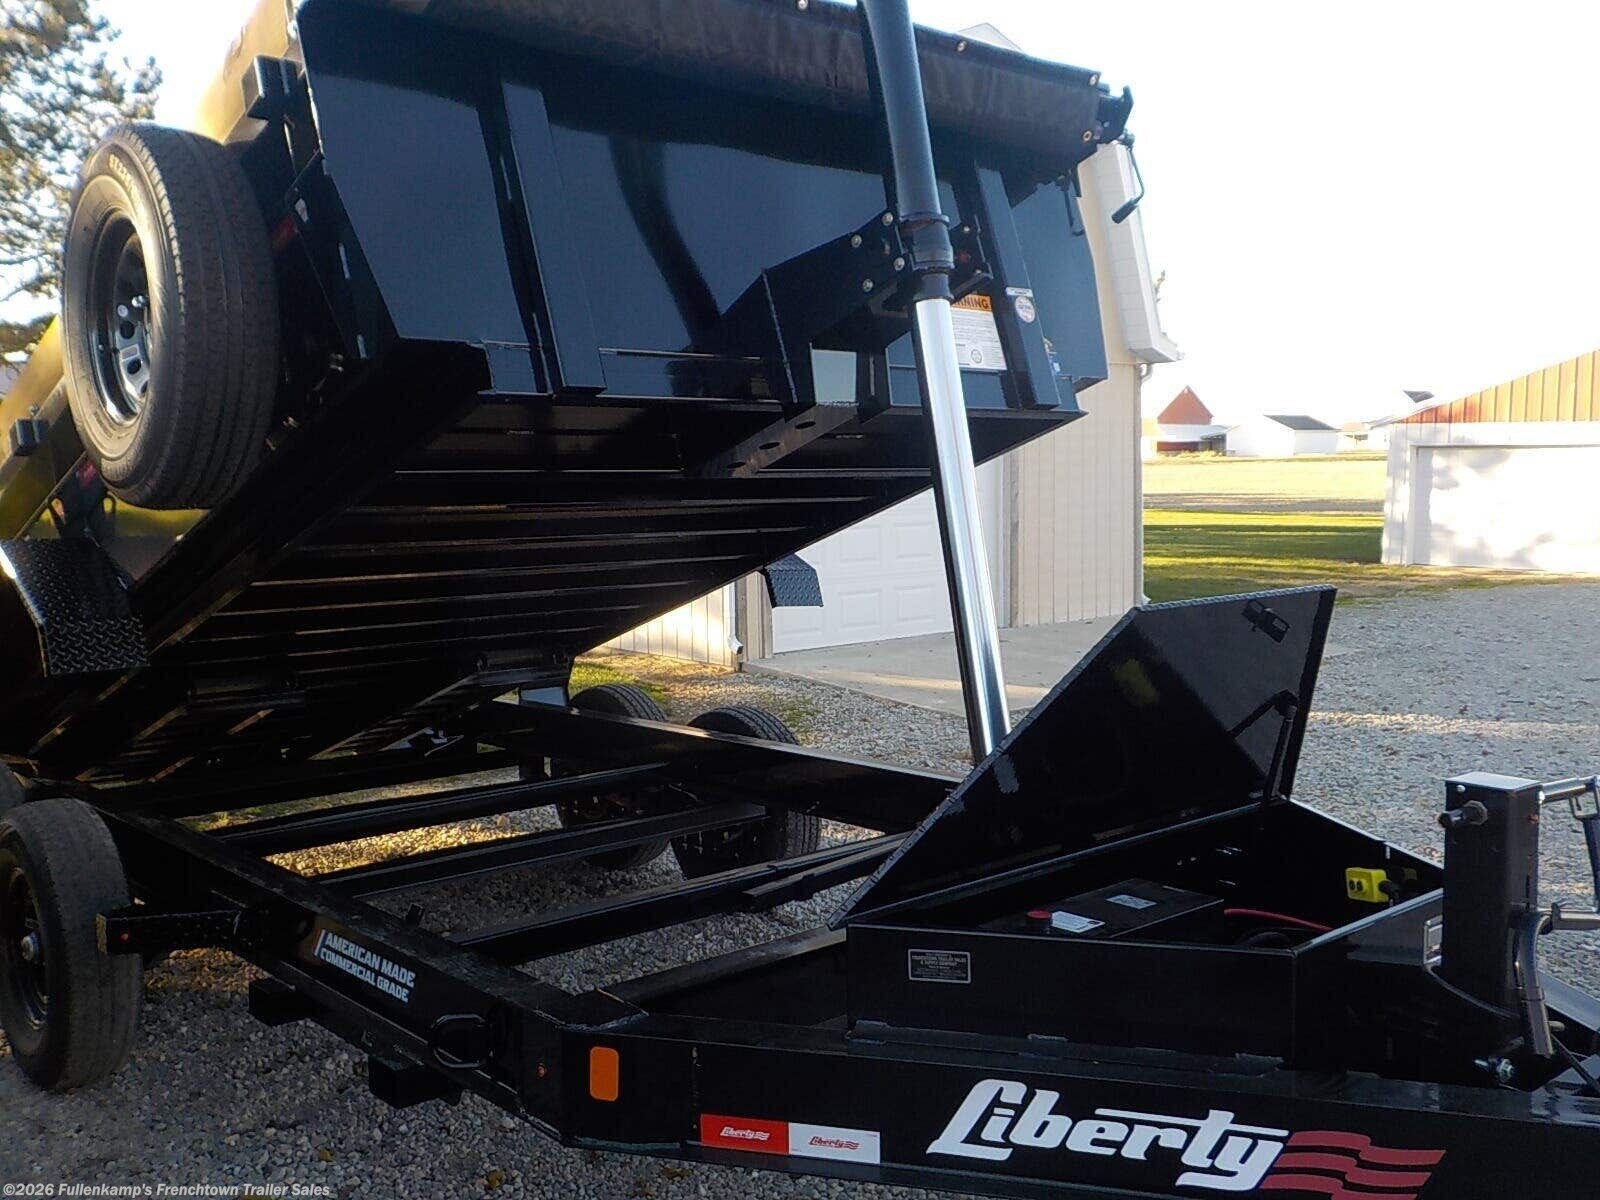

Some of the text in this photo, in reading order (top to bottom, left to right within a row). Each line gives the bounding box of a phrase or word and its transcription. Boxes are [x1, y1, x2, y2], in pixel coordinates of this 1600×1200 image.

[320, 947, 410, 1003] COMMERCIAL GRADE
[326, 932, 416, 988] AMERICAN MADE
[720, 1126, 754, 1139] Liberty
[809, 1136, 845, 1148] Liberty
[925, 1078, 1290, 1192] Liberty
